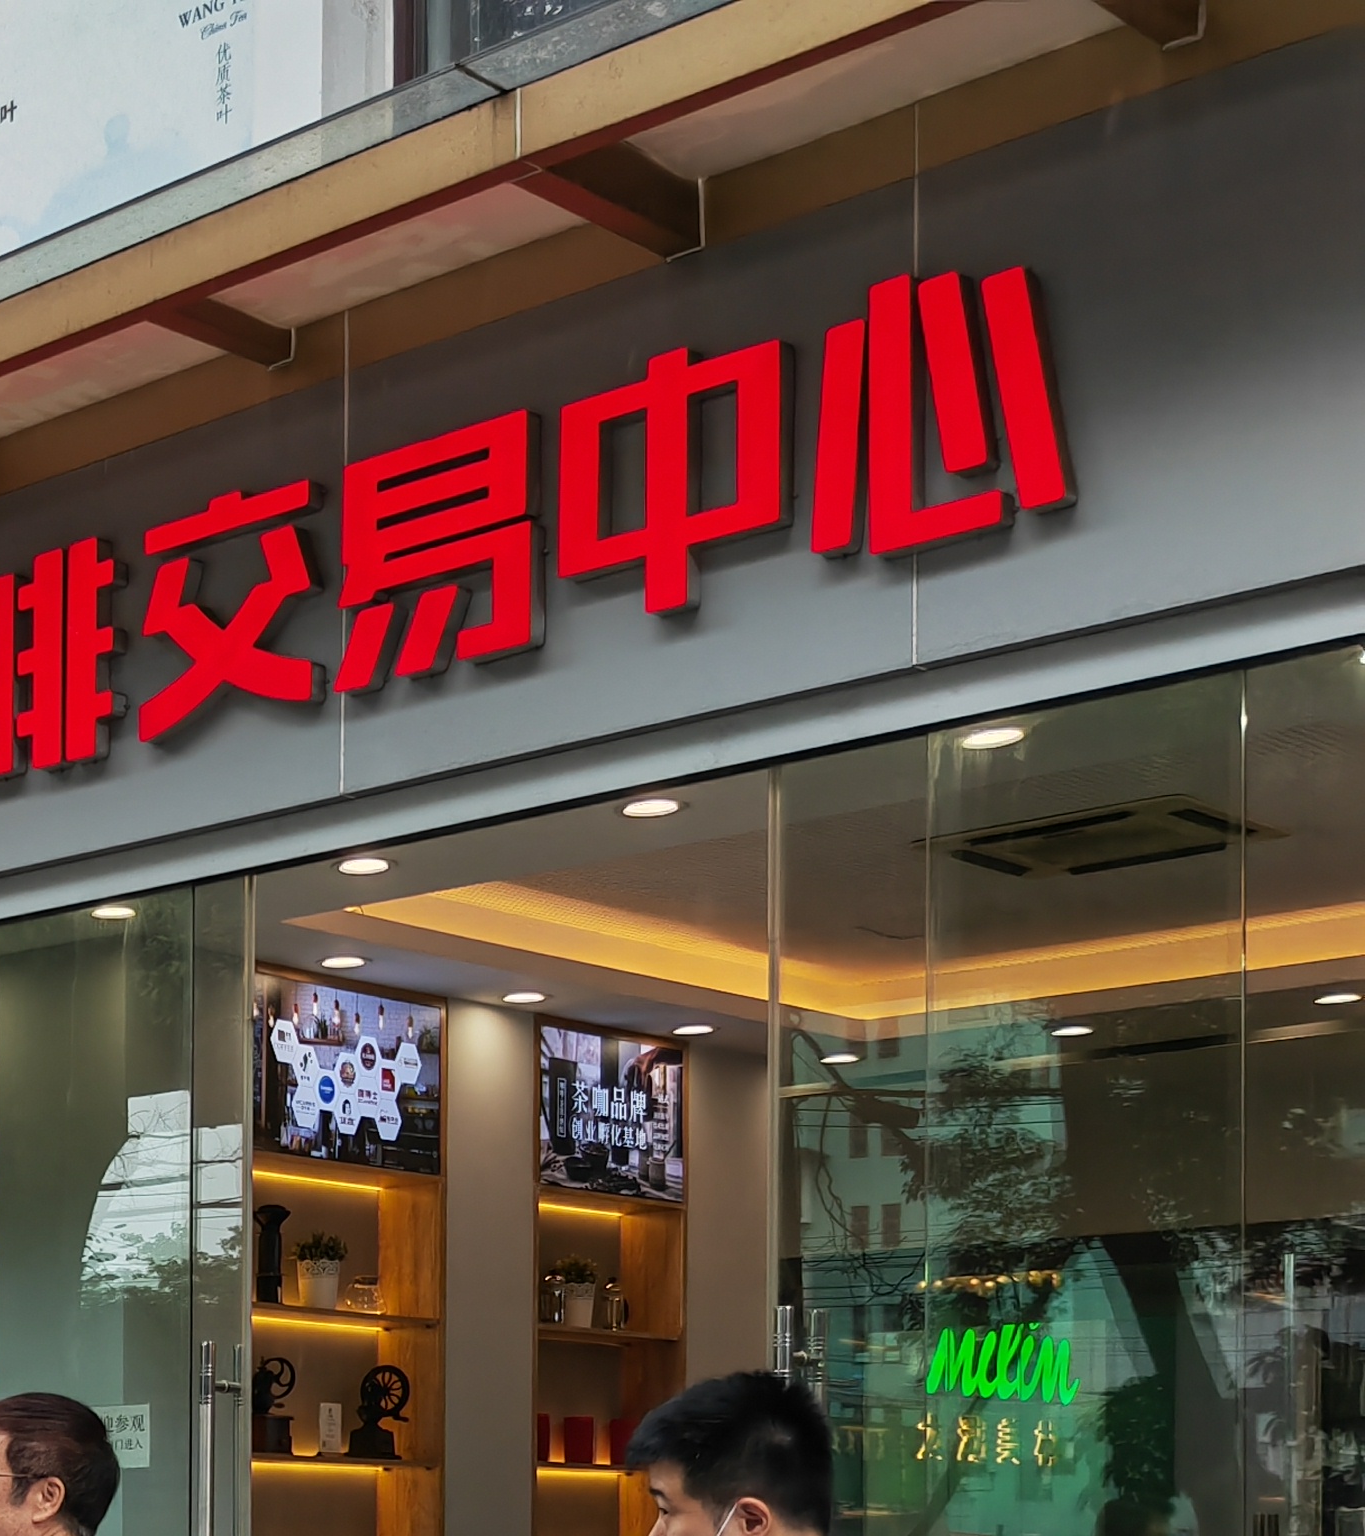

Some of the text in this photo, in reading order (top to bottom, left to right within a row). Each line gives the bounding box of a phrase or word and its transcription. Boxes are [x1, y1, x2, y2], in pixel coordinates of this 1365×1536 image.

[216, 42, 232, 124] 优质茶叶
[572, 1081, 647, 1123] 茶咖品牌
[572, 1117, 648, 1150] 创业孵化基地
[112, 1438, 144, 1451] 门进入
